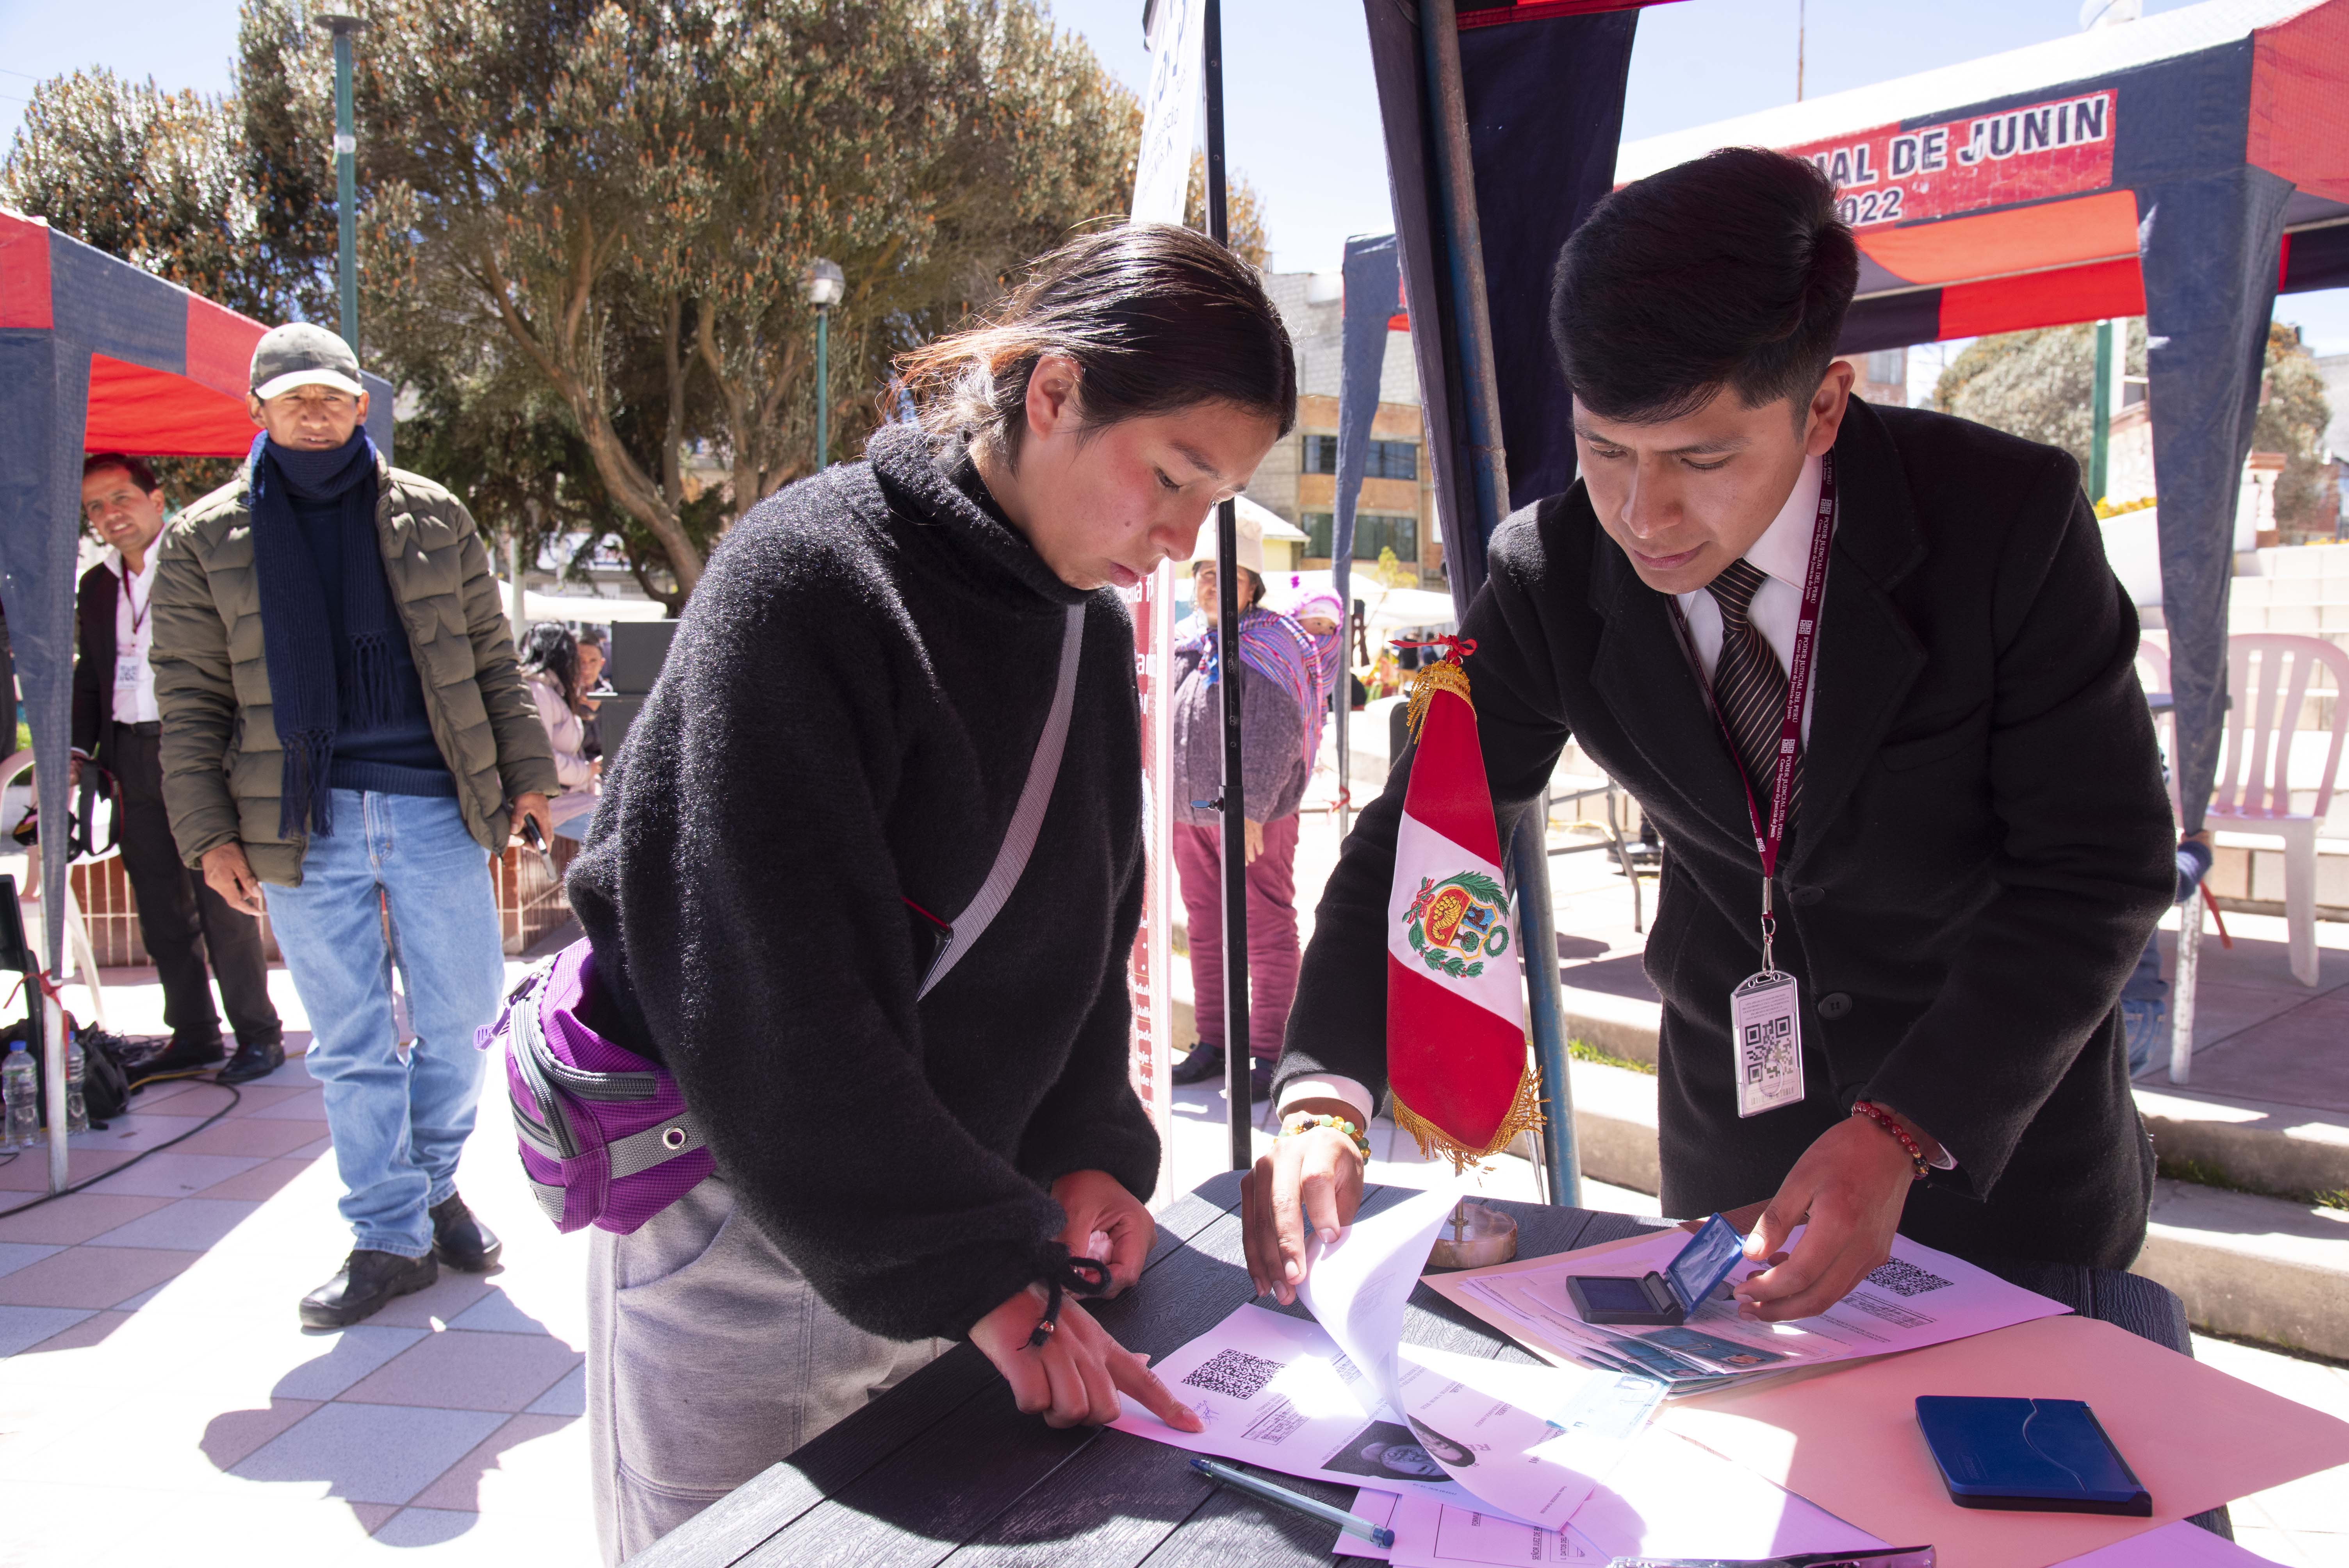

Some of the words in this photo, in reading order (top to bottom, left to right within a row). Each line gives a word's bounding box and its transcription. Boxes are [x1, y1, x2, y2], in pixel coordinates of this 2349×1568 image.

[1890, 130, 1947, 178] DE
[1957, 96, 2108, 164] JUNIN
[1821, 516, 1829, 539] PODER
[1812, 533, 1821, 554] Superior
[1816, 539, 1825, 571] JUDICIAL
[1796, 659, 1805, 690] JUDICIAL
[1531, 1546, 1539, 1560] SEÑOR
